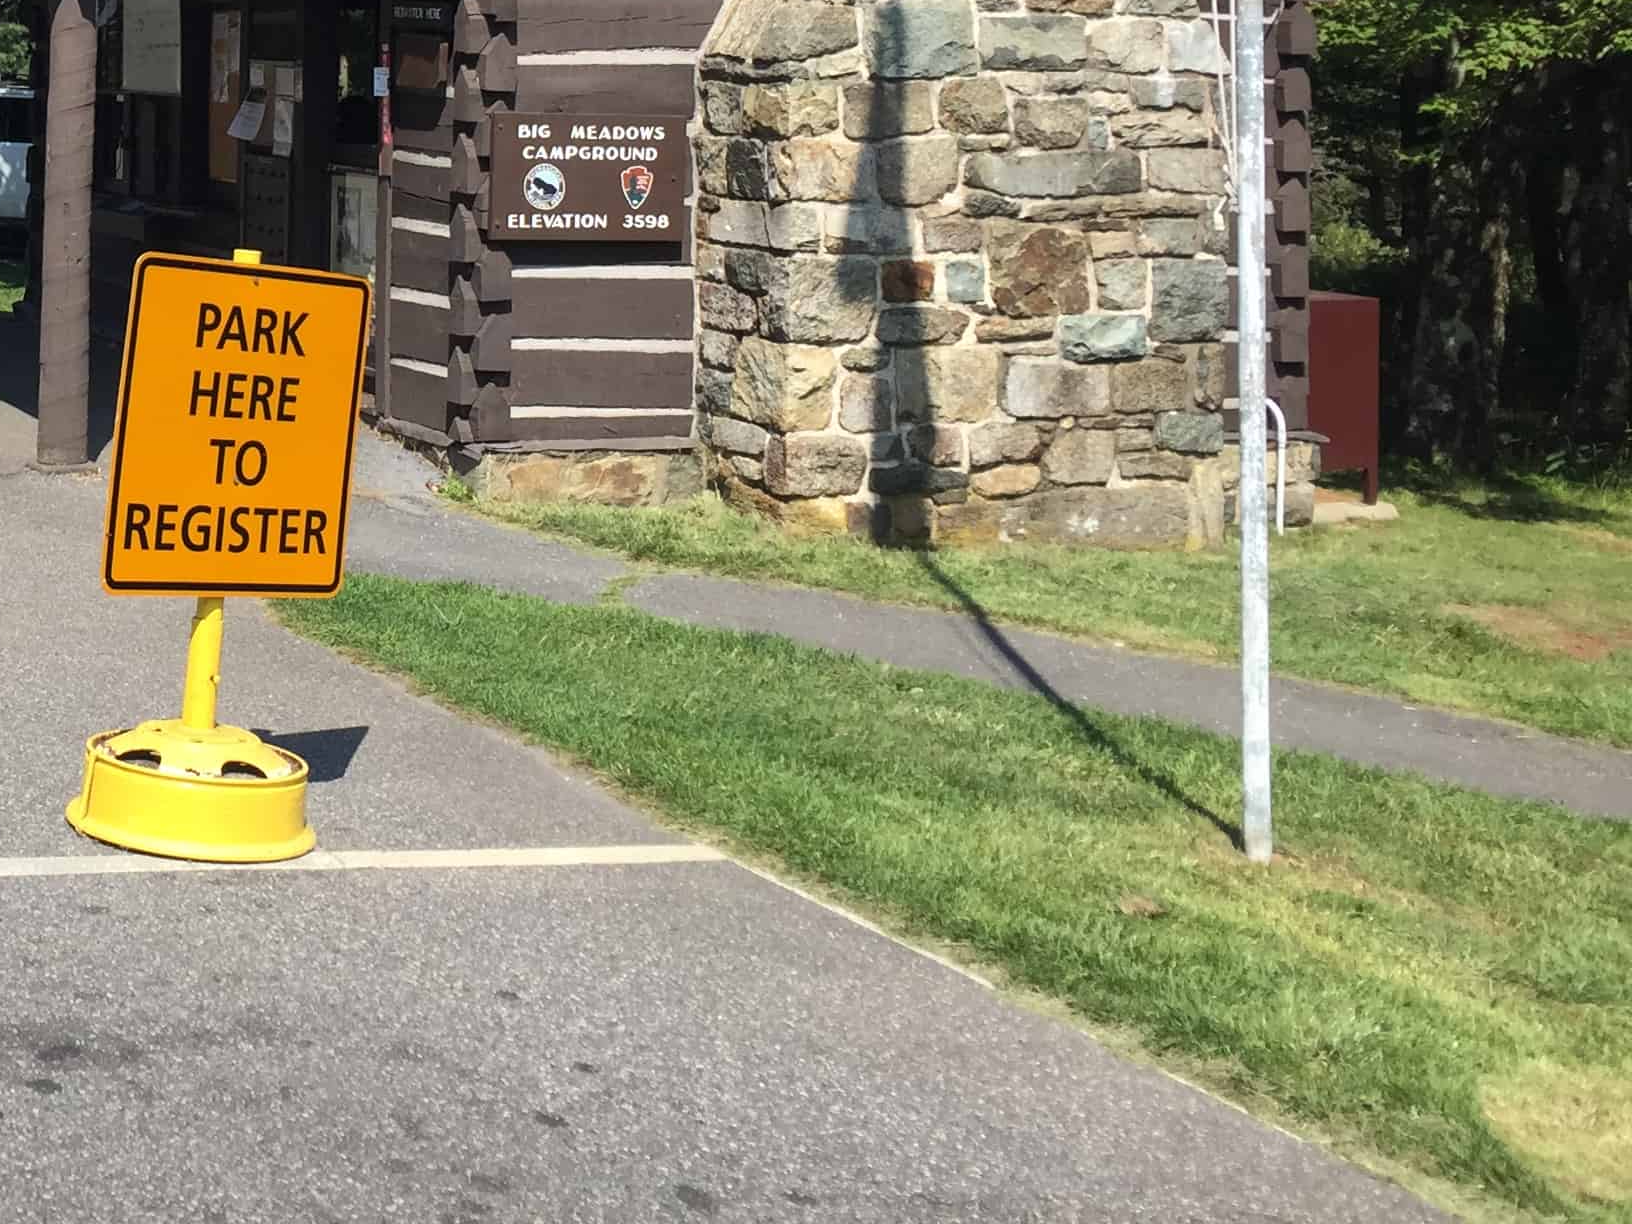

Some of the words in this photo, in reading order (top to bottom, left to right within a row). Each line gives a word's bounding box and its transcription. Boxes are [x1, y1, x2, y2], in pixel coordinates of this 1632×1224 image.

[517, 124, 552, 139] BIG
[570, 125, 666, 141] MEADOWS
[522, 146, 658, 161] CAMPGROUND
[507, 214, 607, 229] ELEVATION
[622, 214, 670, 229] 3598
[195, 302, 310, 357] PARK
[189, 370, 301, 423] HERE
[209, 438, 268, 487] TO
[123, 502, 328, 555] REGISTER
